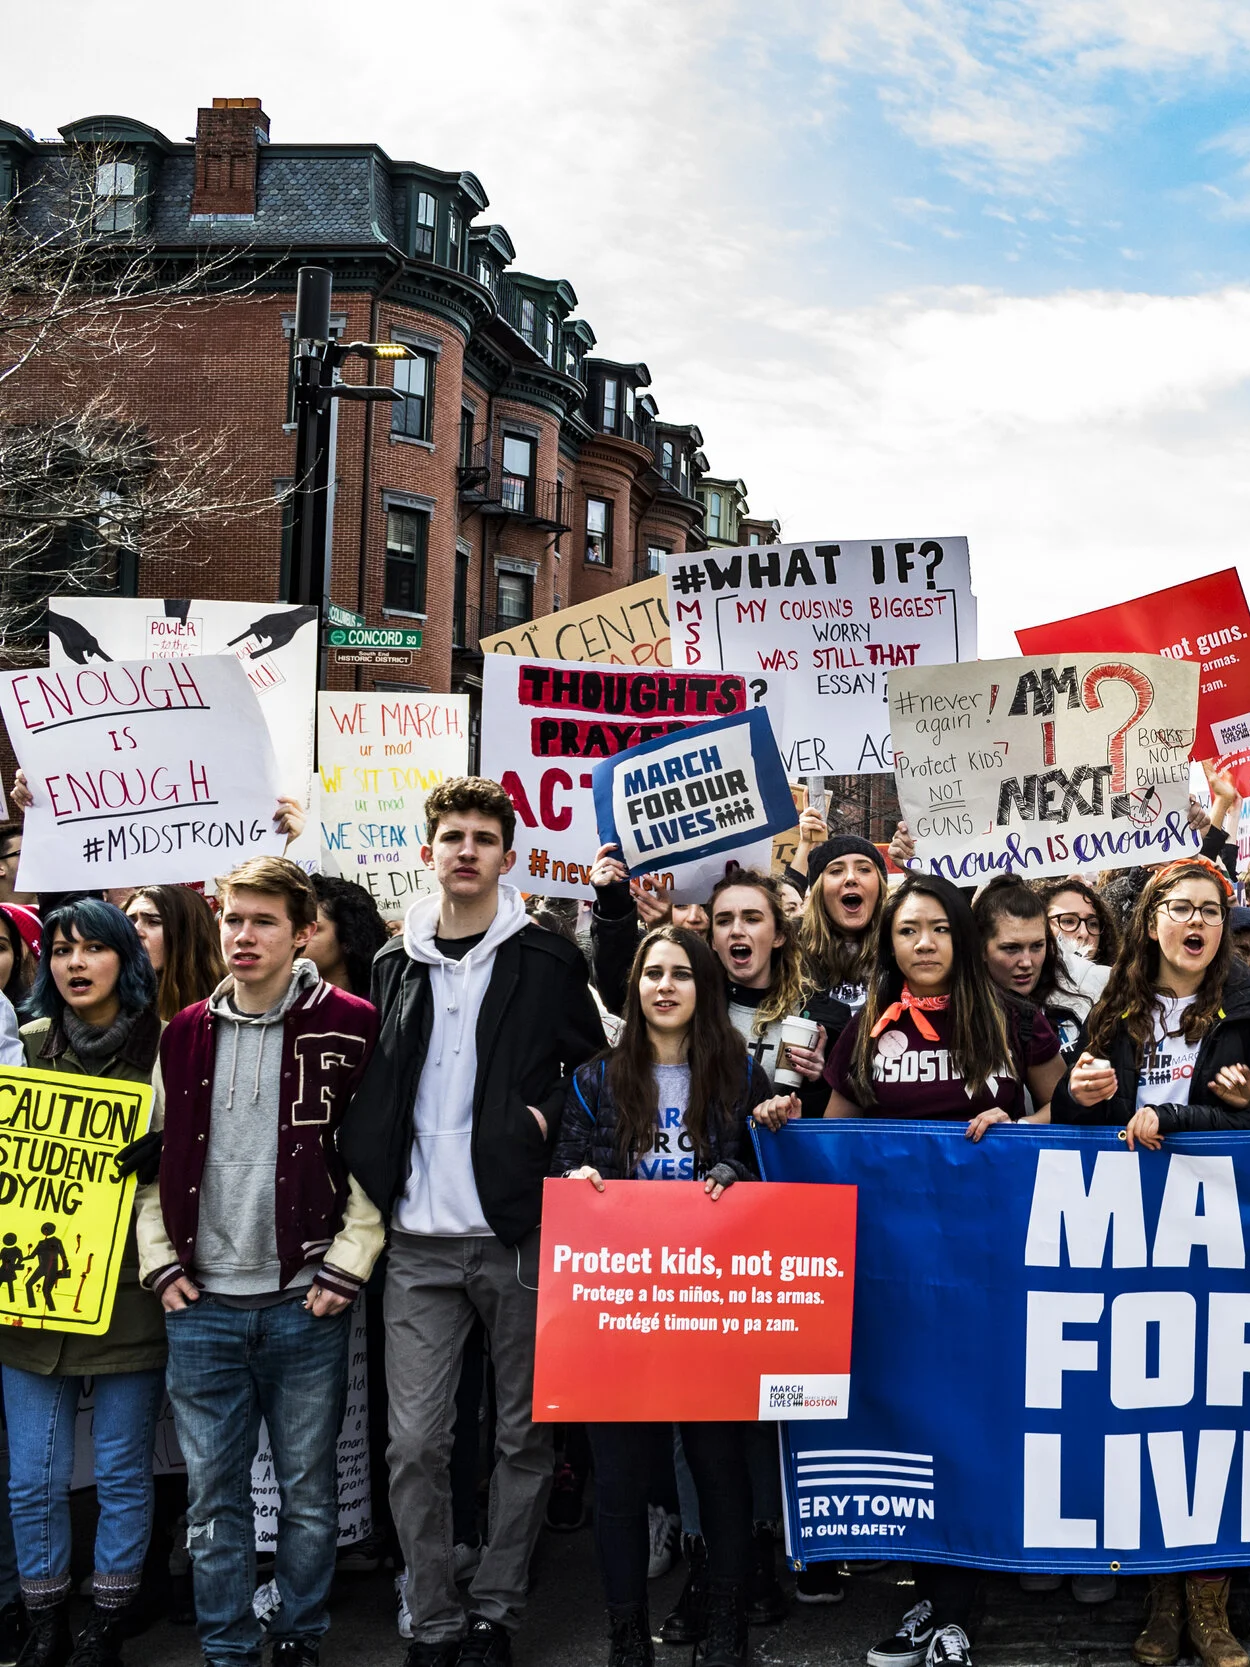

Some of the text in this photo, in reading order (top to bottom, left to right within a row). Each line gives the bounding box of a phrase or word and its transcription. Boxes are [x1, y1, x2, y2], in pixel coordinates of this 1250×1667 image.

[671, 540, 944, 594] #WHAT IF?
[736, 595, 947, 623] MY COUSIN'S BIGGEST
[151, 621, 196, 636] POWER
[348, 630, 417, 645] CONCORD SQ
[812, 623, 870, 642] WORRY
[1196, 625, 1248, 655] guns.
[757, 643, 920, 671] WAS STILL THAT
[1202, 653, 1240, 672] armas.
[11, 662, 206, 730] ENOUGH
[1009, 666, 1081, 717] AM
[1200, 679, 1227, 694] zam.
[894, 692, 982, 716] #never
[329, 702, 464, 739] WE MARCH,
[1220, 722, 1247, 734] MARCH
[108, 727, 138, 752] IS
[360, 740, 413, 757] ur mad
[1041, 721, 1057, 767] I
[1138, 727, 1185, 747] BOOKS
[1223, 735, 1241, 745] LIVES
[899, 752, 958, 779] Protect
[1148, 747, 1180, 763] NOT
[319, 764, 348, 793] WE
[353, 768, 384, 794] SIT
[623, 745, 724, 797] MARCH
[1136, 762, 1190, 786] BULLETS
[45, 760, 212, 818] ENOUGH
[627, 768, 749, 825] FOR OUR
[929, 780, 963, 801] NOT
[996, 764, 1113, 826] NEXT
[355, 795, 405, 812] ur mad
[320, 822, 408, 850] WE SPEAK
[632, 808, 717, 853] LIVES
[917, 814, 973, 838] GUNS
[1047, 811, 1201, 866] IS enough
[83, 818, 268, 863] #MSDSTRONG
[357, 851, 400, 865] ur mad
[388, 869, 431, 897] DIE,
[292, 1031, 367, 1127] F
[0, 1083, 136, 1143] CAUTION
[0, 1171, 84, 1216] DYING
[553, 1244, 844, 1281] Protect kids, not guns.
[572, 1283, 825, 1305] Protege a los niños, no las armas.
[598, 1311, 799, 1334] Protégé timoun yo pa zam.
[769, 1399, 838, 1408] LIVES BOSTON
[816, 1524, 906, 1537] GUN SAFETY
